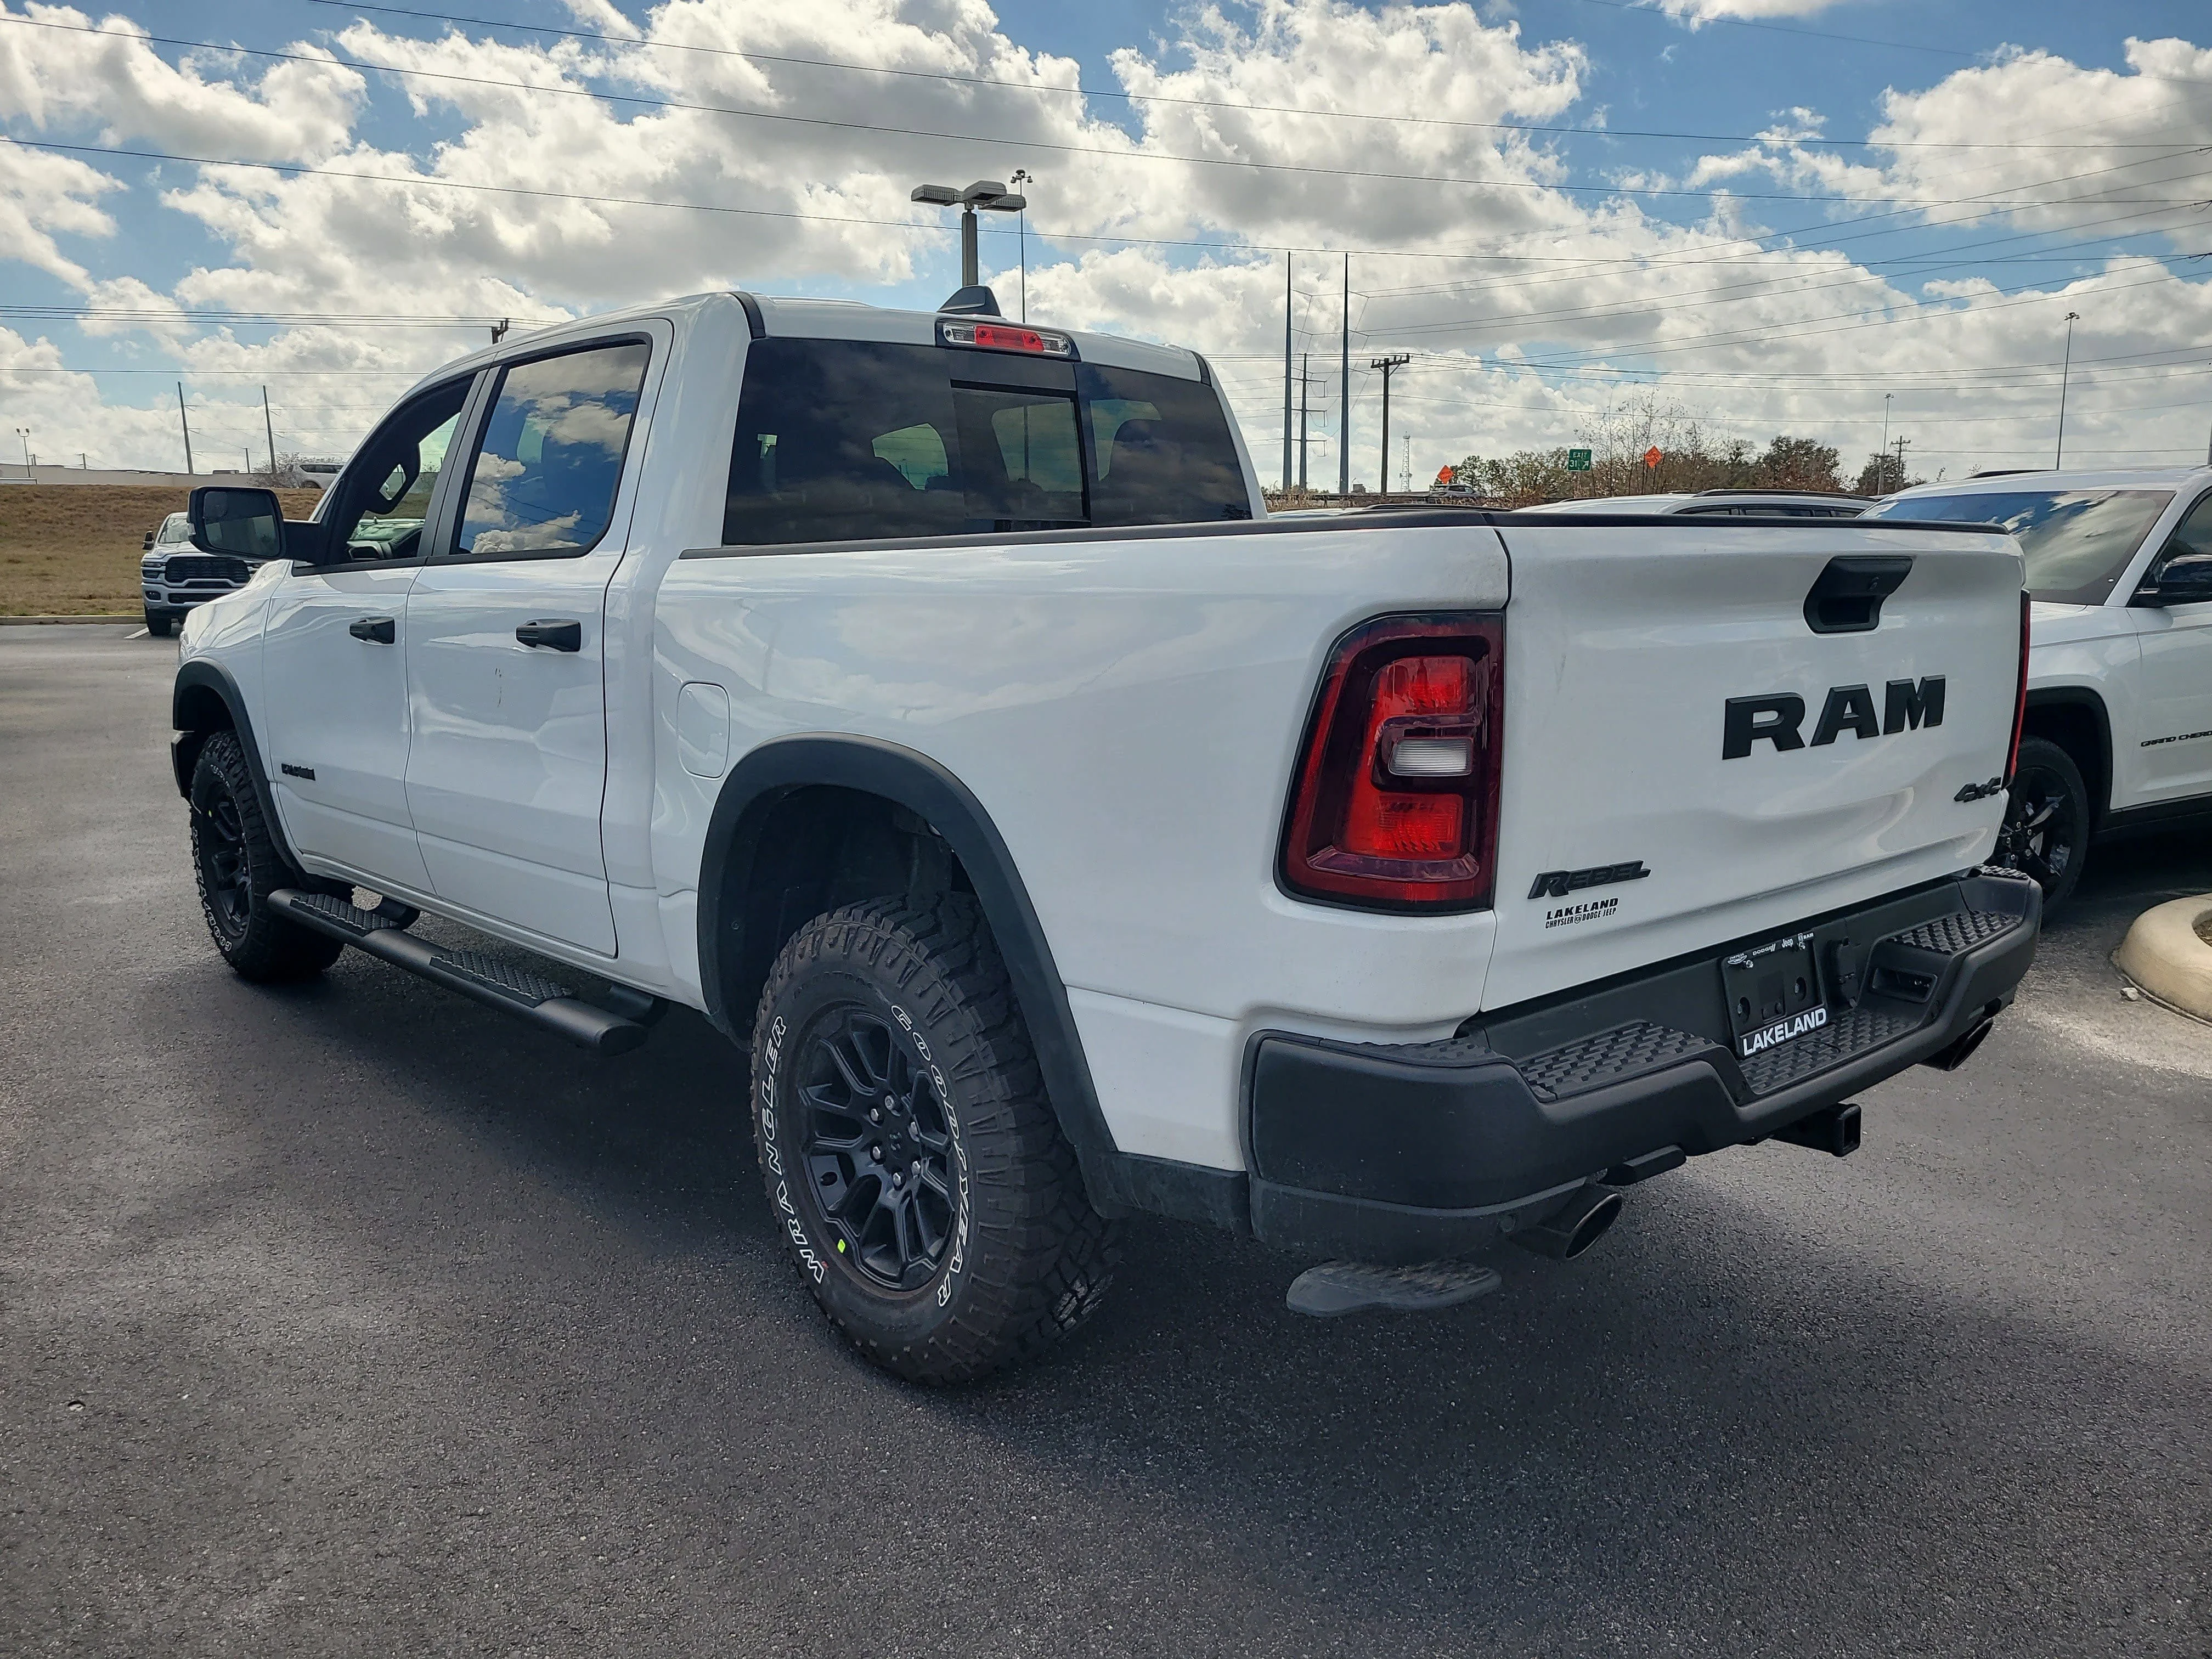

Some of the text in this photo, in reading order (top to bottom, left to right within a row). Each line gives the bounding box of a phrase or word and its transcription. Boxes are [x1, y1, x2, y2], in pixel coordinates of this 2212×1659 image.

[1722, 674, 1946, 759] RAM
[2141, 736, 2177, 747] GRAND
[1527, 860, 1651, 899] REBEL
[1545, 907, 1617, 929] CHRYSLER DODGE JEEP
[1546, 898, 1618, 920] LAKELAND
[1752, 944, 1774, 955] DODGE
[1781, 939, 1793, 948] Jeep
[1743, 1008, 1827, 1056] LAKELAND
[760, 1015, 825, 1283] WRANGLER
[890, 1005, 972, 1307] GOODYEAR
